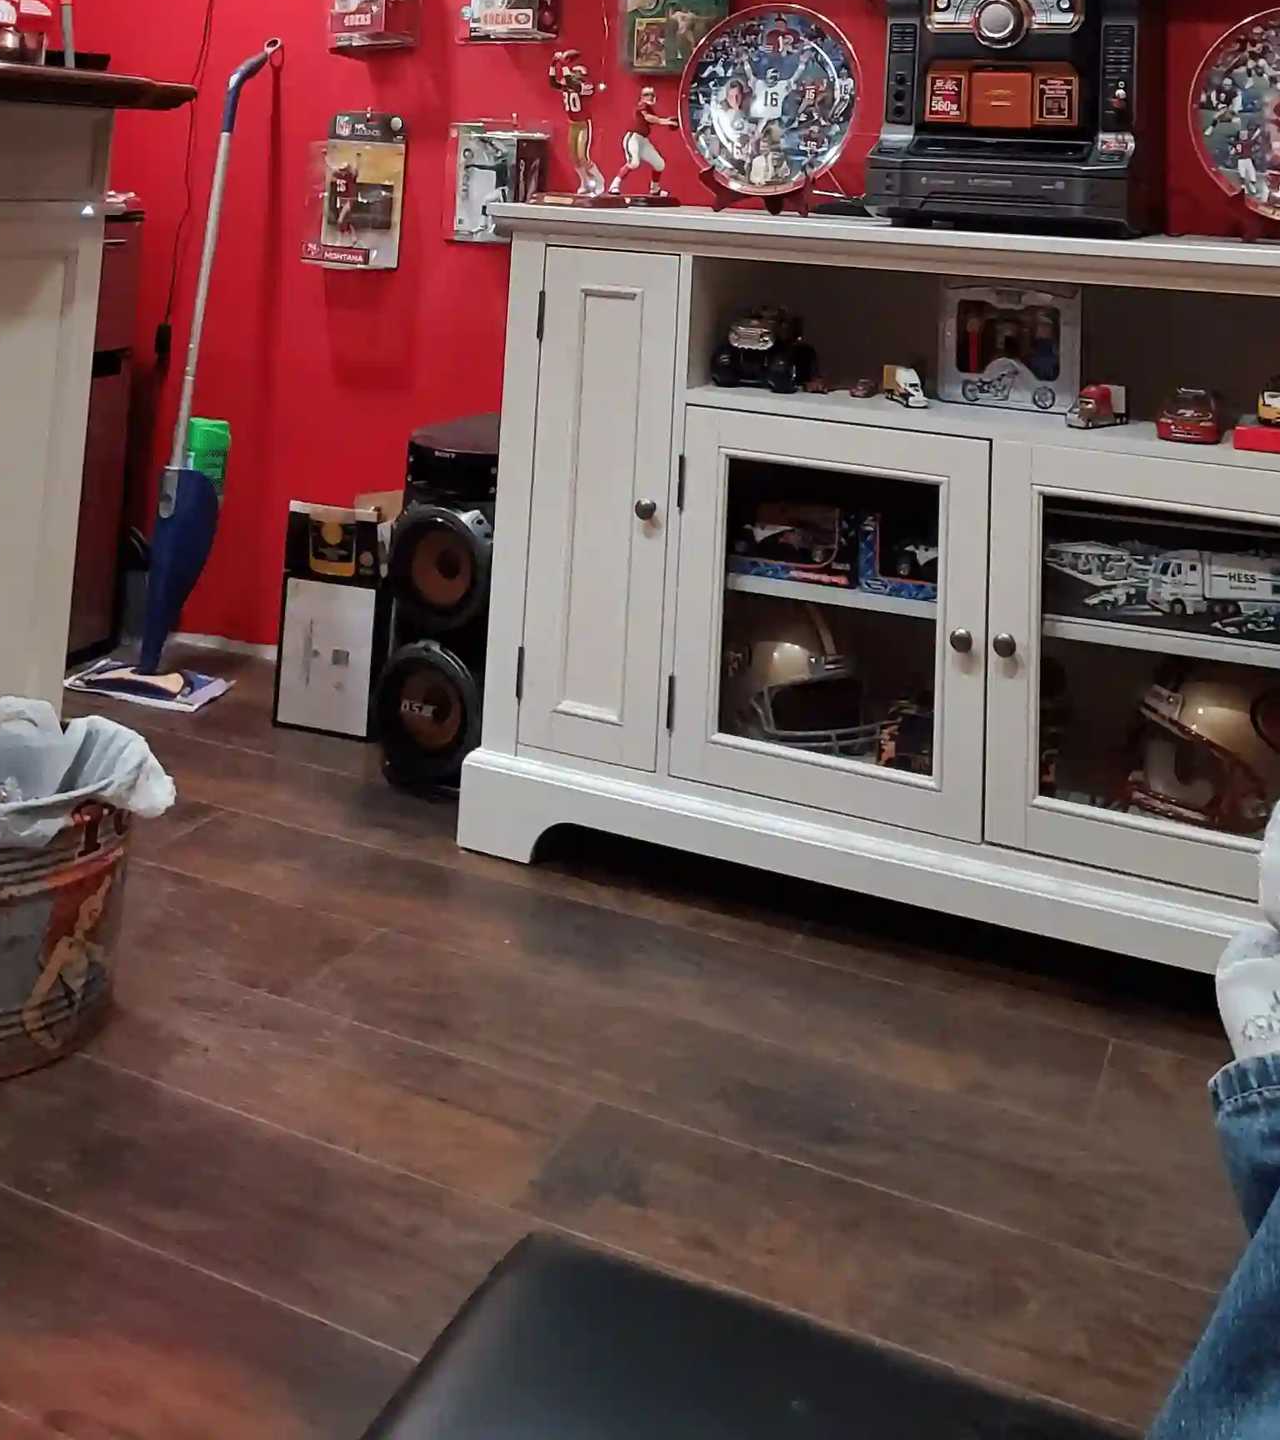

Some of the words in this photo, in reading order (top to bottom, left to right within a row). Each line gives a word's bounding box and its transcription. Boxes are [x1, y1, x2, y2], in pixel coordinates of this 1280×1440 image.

[762, 90, 779, 108] 16
[323, 250, 364, 263] MONTANA
[1228, 572, 1257, 584] HESS
